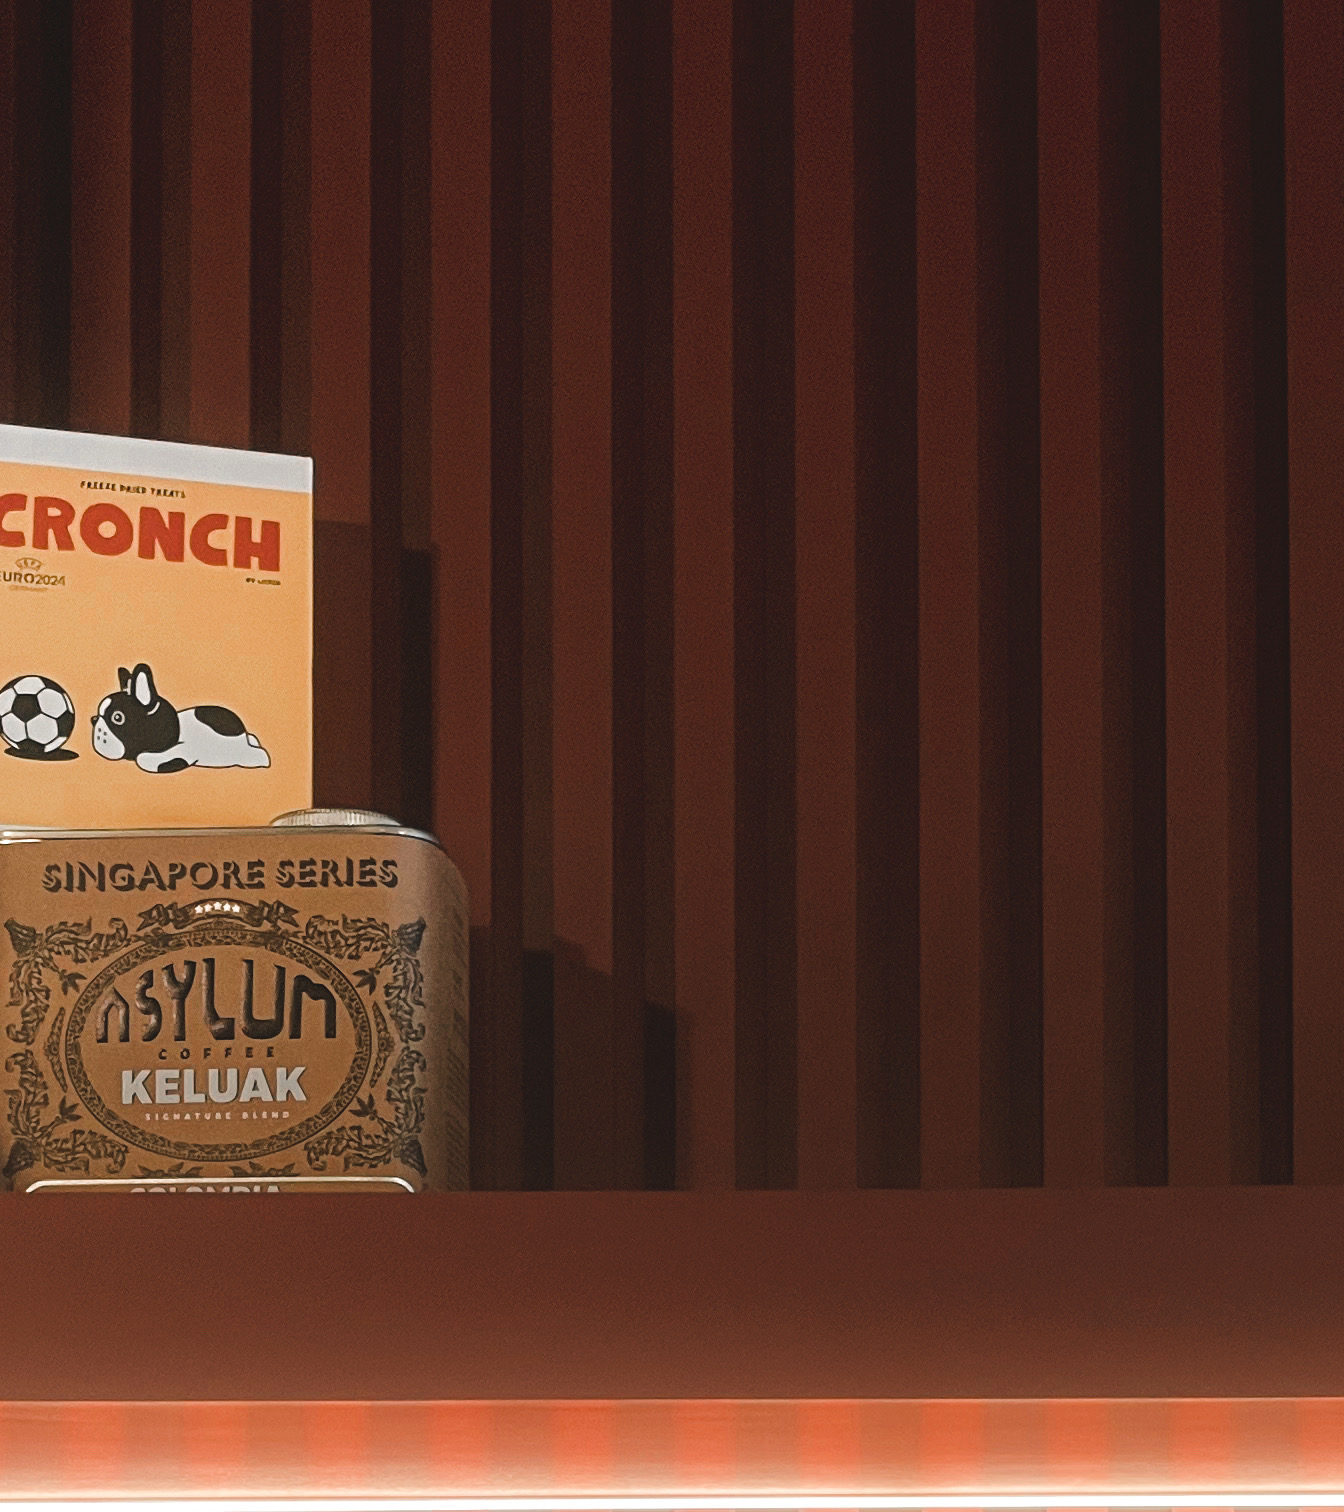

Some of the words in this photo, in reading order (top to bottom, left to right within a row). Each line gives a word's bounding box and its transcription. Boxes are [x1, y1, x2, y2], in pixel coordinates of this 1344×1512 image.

[41, 858, 267, 893] SINGAPORE
[275, 857, 400, 889] SERIES
[95, 957, 337, 1044] ASYLUM
[158, 1046, 275, 1060] COFFEE
[121, 1066, 308, 1105] KELUAK
[144, 1112, 232, 1122] SIGNATURE
[242, 1111, 290, 1120] BLEND
